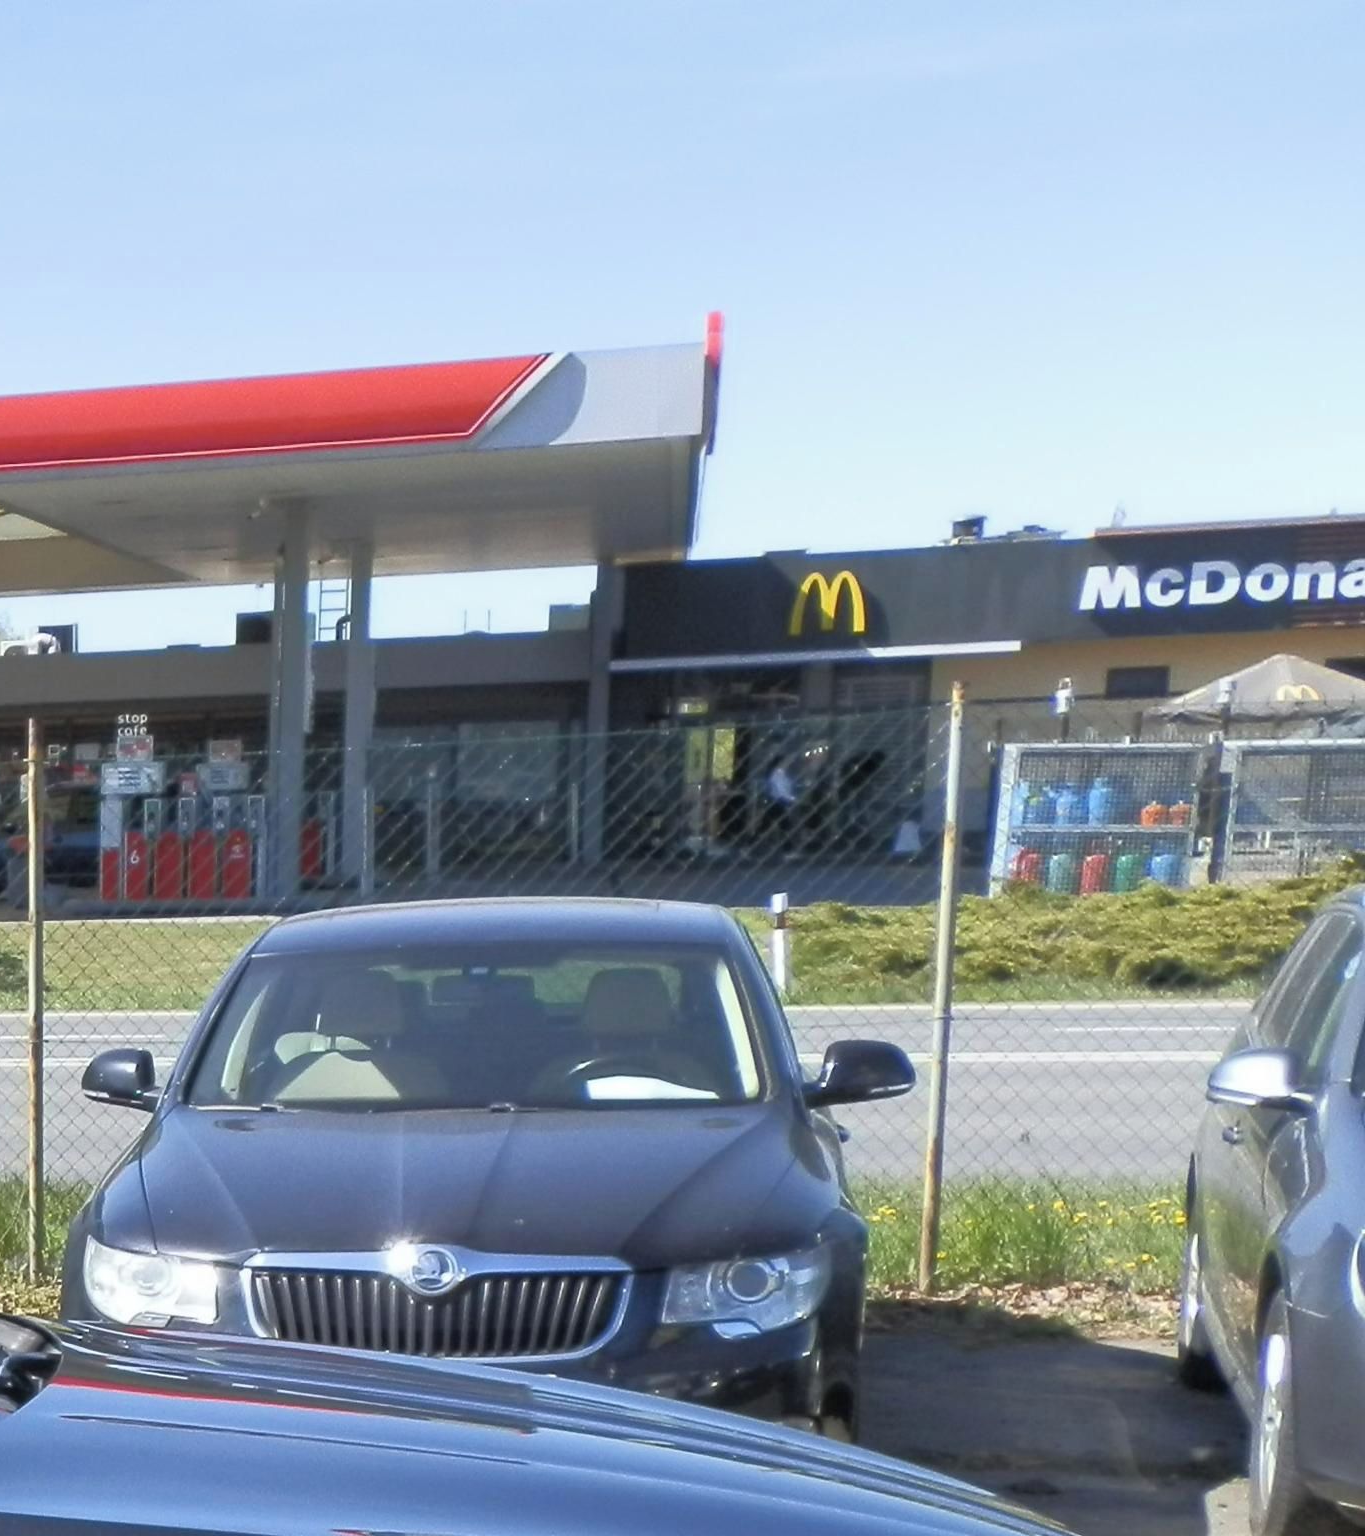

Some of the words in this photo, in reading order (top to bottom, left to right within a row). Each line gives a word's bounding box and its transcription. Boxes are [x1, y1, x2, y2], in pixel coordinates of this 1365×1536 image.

[117, 713, 148, 725] stop
[117, 725, 148, 737] cafe
[130, 850, 140, 865] 6
